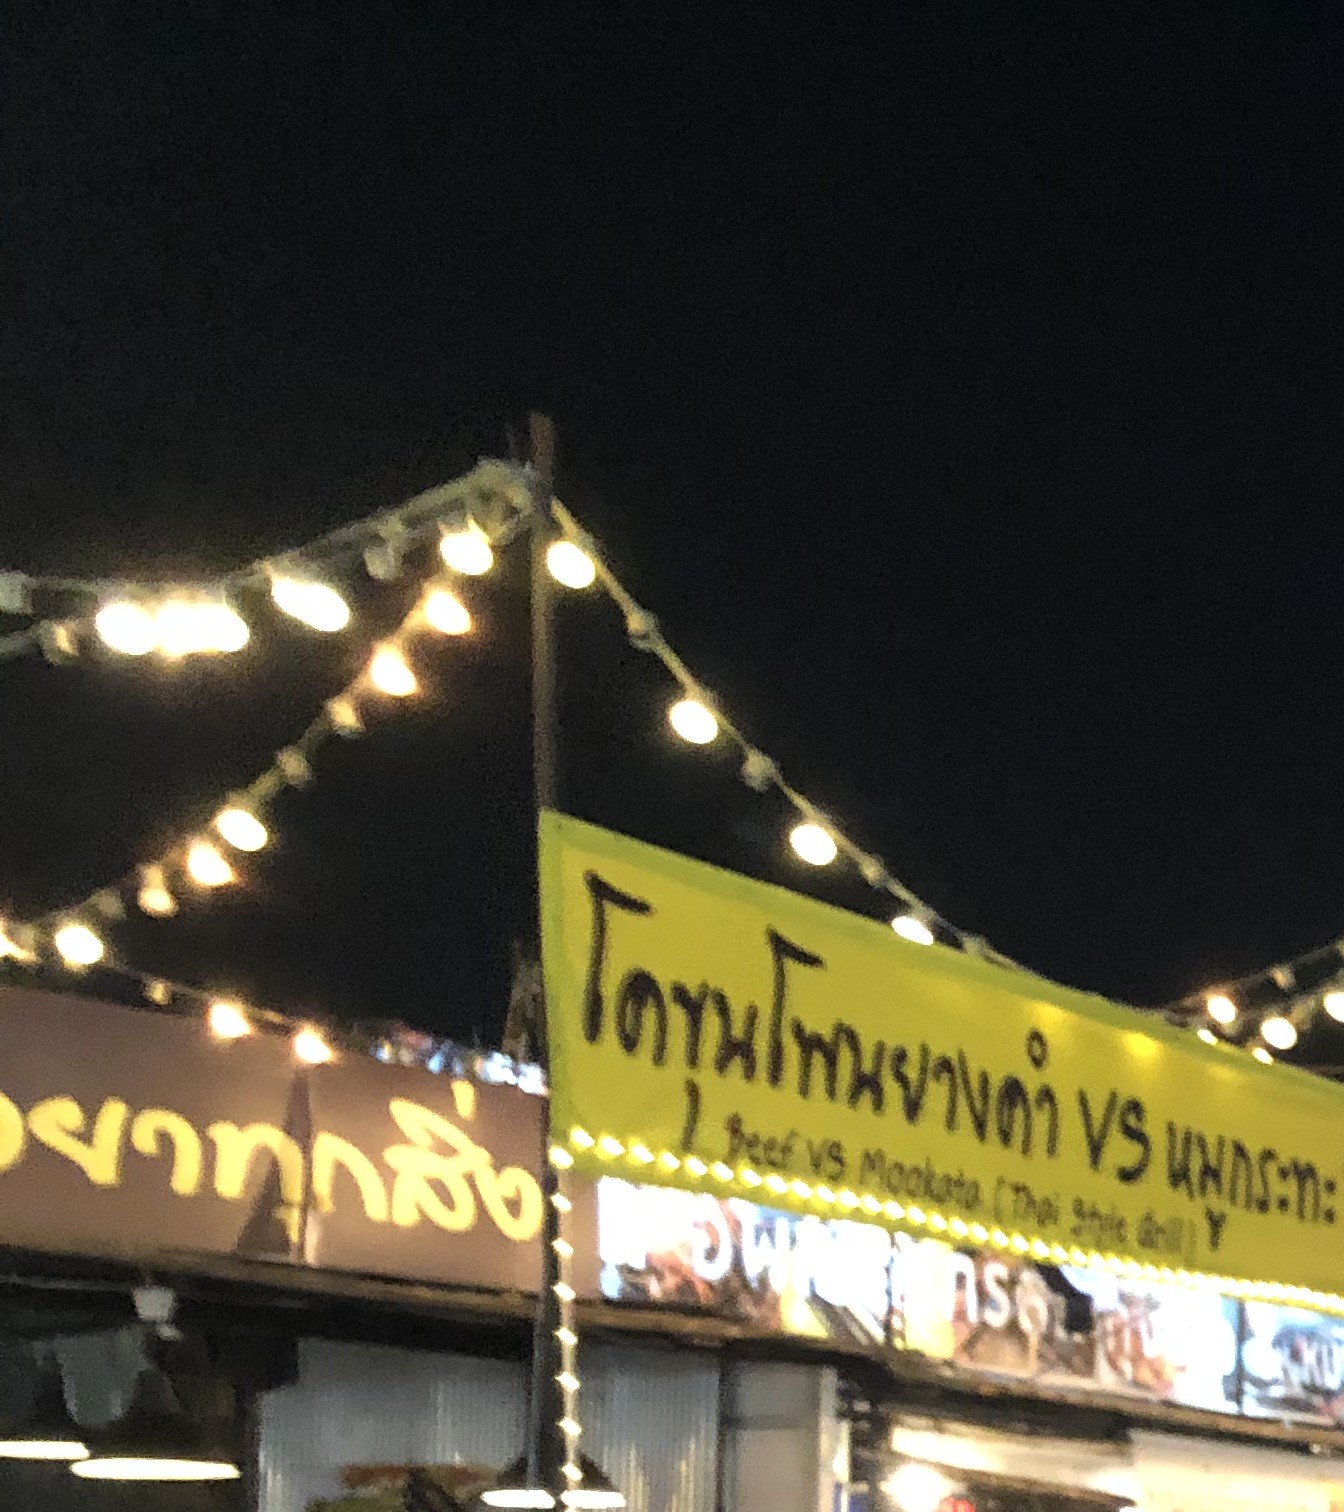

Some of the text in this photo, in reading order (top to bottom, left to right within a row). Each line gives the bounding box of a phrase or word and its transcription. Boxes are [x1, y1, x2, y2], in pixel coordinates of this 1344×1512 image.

[1078, 1088, 1152, 1186] VS
[1166, 1120, 1338, 1251] หมูกระทะ
